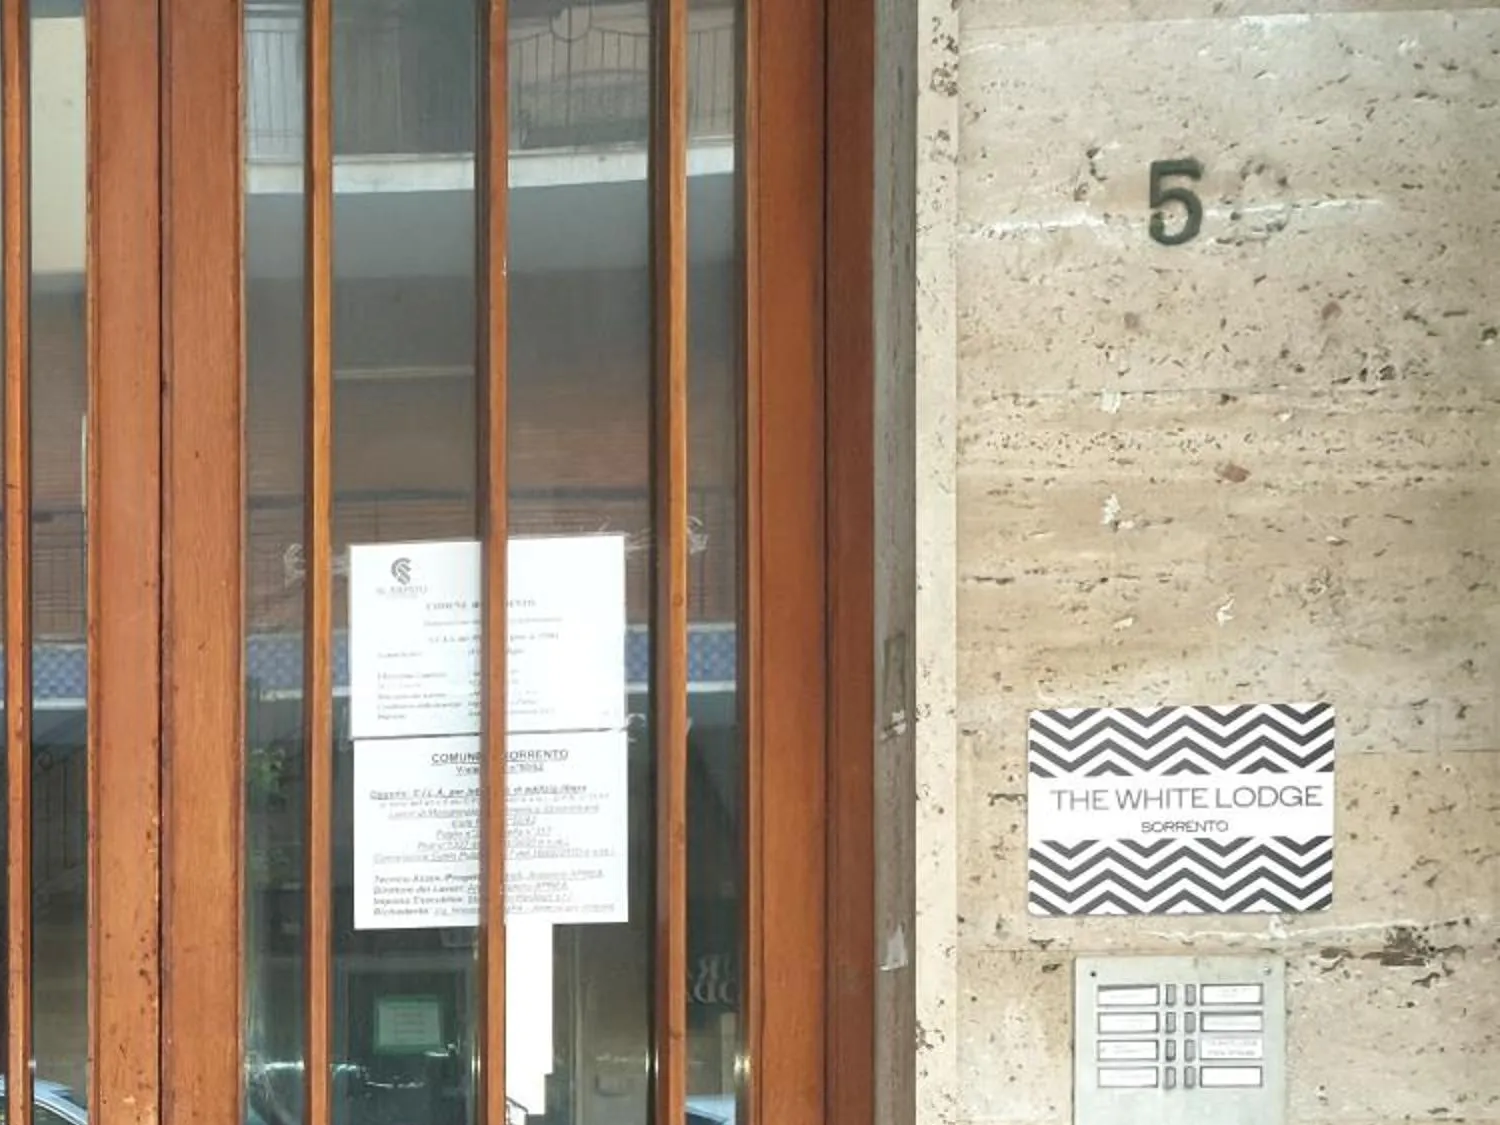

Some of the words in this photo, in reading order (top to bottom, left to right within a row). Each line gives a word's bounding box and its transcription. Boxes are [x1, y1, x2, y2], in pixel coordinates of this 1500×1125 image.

[1149, 157, 1203, 246] 5
[503, 748, 569, 761] ORRENTO
[1050, 789, 1109, 811] THE
[1115, 786, 1208, 810] WHITE
[1215, 785, 1323, 809] LODGE
[1140, 820, 1229, 834] SORRENTO
